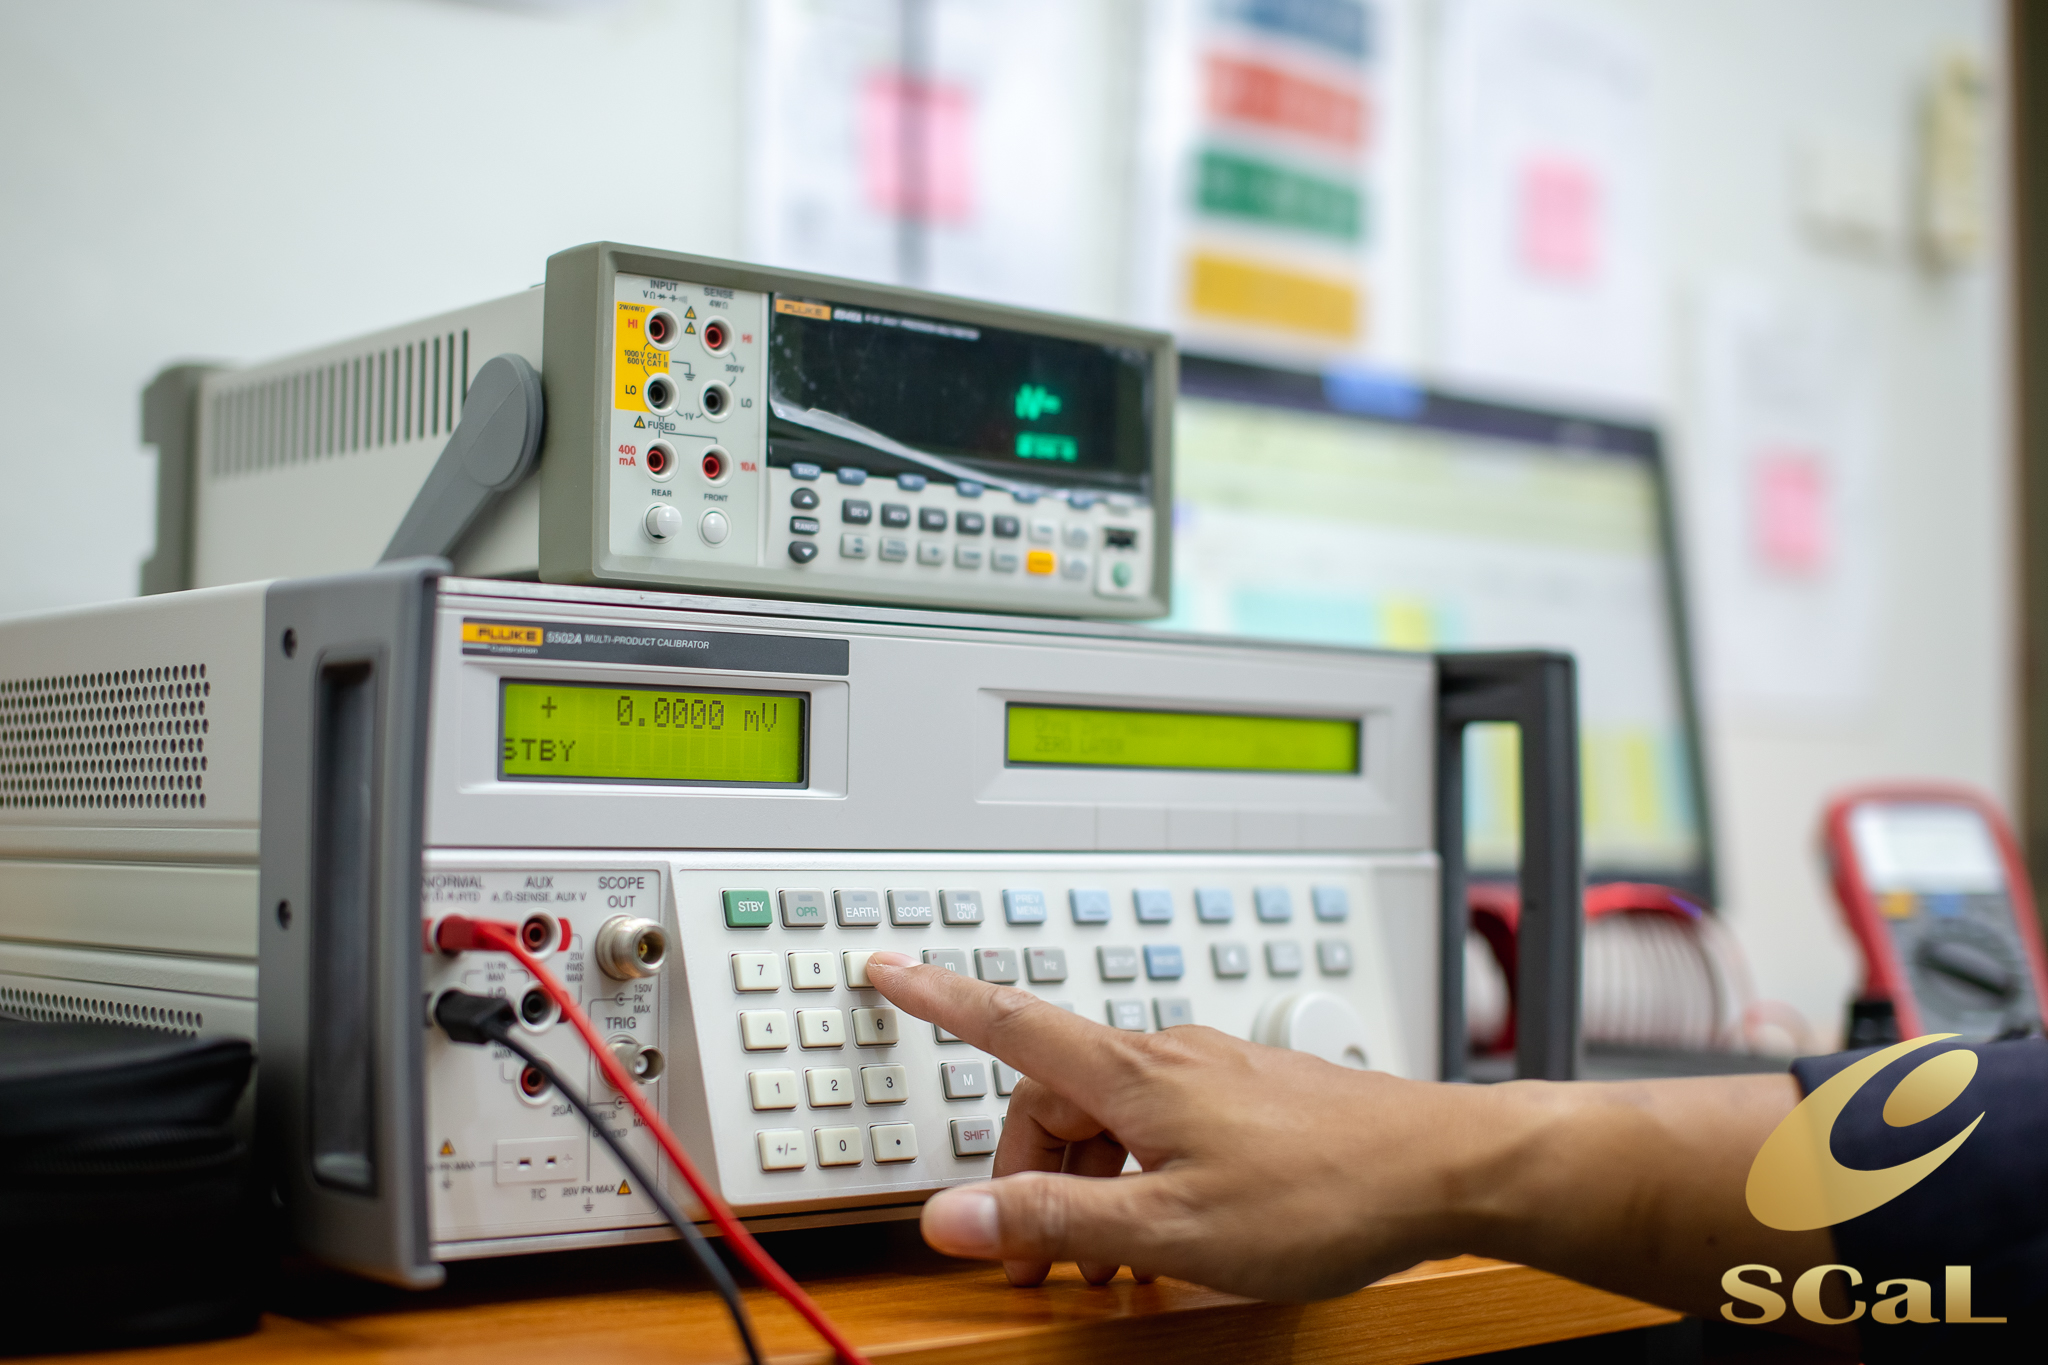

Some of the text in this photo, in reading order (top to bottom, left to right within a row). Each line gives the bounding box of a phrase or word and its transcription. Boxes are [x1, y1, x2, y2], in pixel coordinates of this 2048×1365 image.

[650, 280, 679, 292] INPUT
[704, 287, 735, 300] SENSE
[628, 318, 638, 329] HI
[742, 334, 753, 344] HI
[647, 352, 662, 360] CAT
[647, 359, 662, 368] CAT
[625, 385, 637, 395] LO
[741, 398, 753, 408] LO
[647, 420, 676, 432] FUSED
[618, 444, 637, 456] 400
[619, 456, 637, 467] mA
[651, 488, 673, 498] REAR
[703, 493, 729, 503] FRONT
[794, 520, 819, 533] RANGE
[478, 627, 710, 649] FLUKE 5502A MULTI-PRODUCT CALIBRATOR
[616, 695, 725, 731] 0.0000
[744, 703, 778, 733] mV
[504, 738, 576, 762] STBY
[524, 876, 553, 889] AUX
[598, 876, 645, 890] SCOPE
[607, 895, 636, 908] OUT
[1015, 894, 1040, 905] PREV
[737, 901, 765, 913] STBY
[796, 906, 818, 917] OPR
[845, 907, 880, 918] EARTH
[897, 907, 932, 918] SCOPE
[954, 903, 977, 912] TRIG
[1016, 905, 1043, 916] MENU
[957, 911, 976, 920] OUT
[756, 964, 764, 976] 7
[813, 962, 821, 974] 8
[996, 960, 1005, 972] V
[1044, 960, 1057, 971] Hz
[634, 984, 653, 993] 150V
[633, 995, 644, 1003] PK
[633, 1005, 651, 1013] MAX
[605, 1017, 637, 1029] TRIG
[765, 1022, 773, 1034] 4
[821, 1020, 830, 1033] 5
[876, 1019, 884, 1031] 6
[830, 1079, 839, 1092] 2
[885, 1076, 894, 1089] 3
[962, 1074, 974, 1086] M
[775, 1082, 781, 1094] 1
[551, 1105, 574, 1116] 20A
[963, 1130, 991, 1141] SHIFT
[839, 1140, 847, 1152] 0
[531, 1187, 547, 1200] TC
[595, 1183, 616, 1194] MAX
